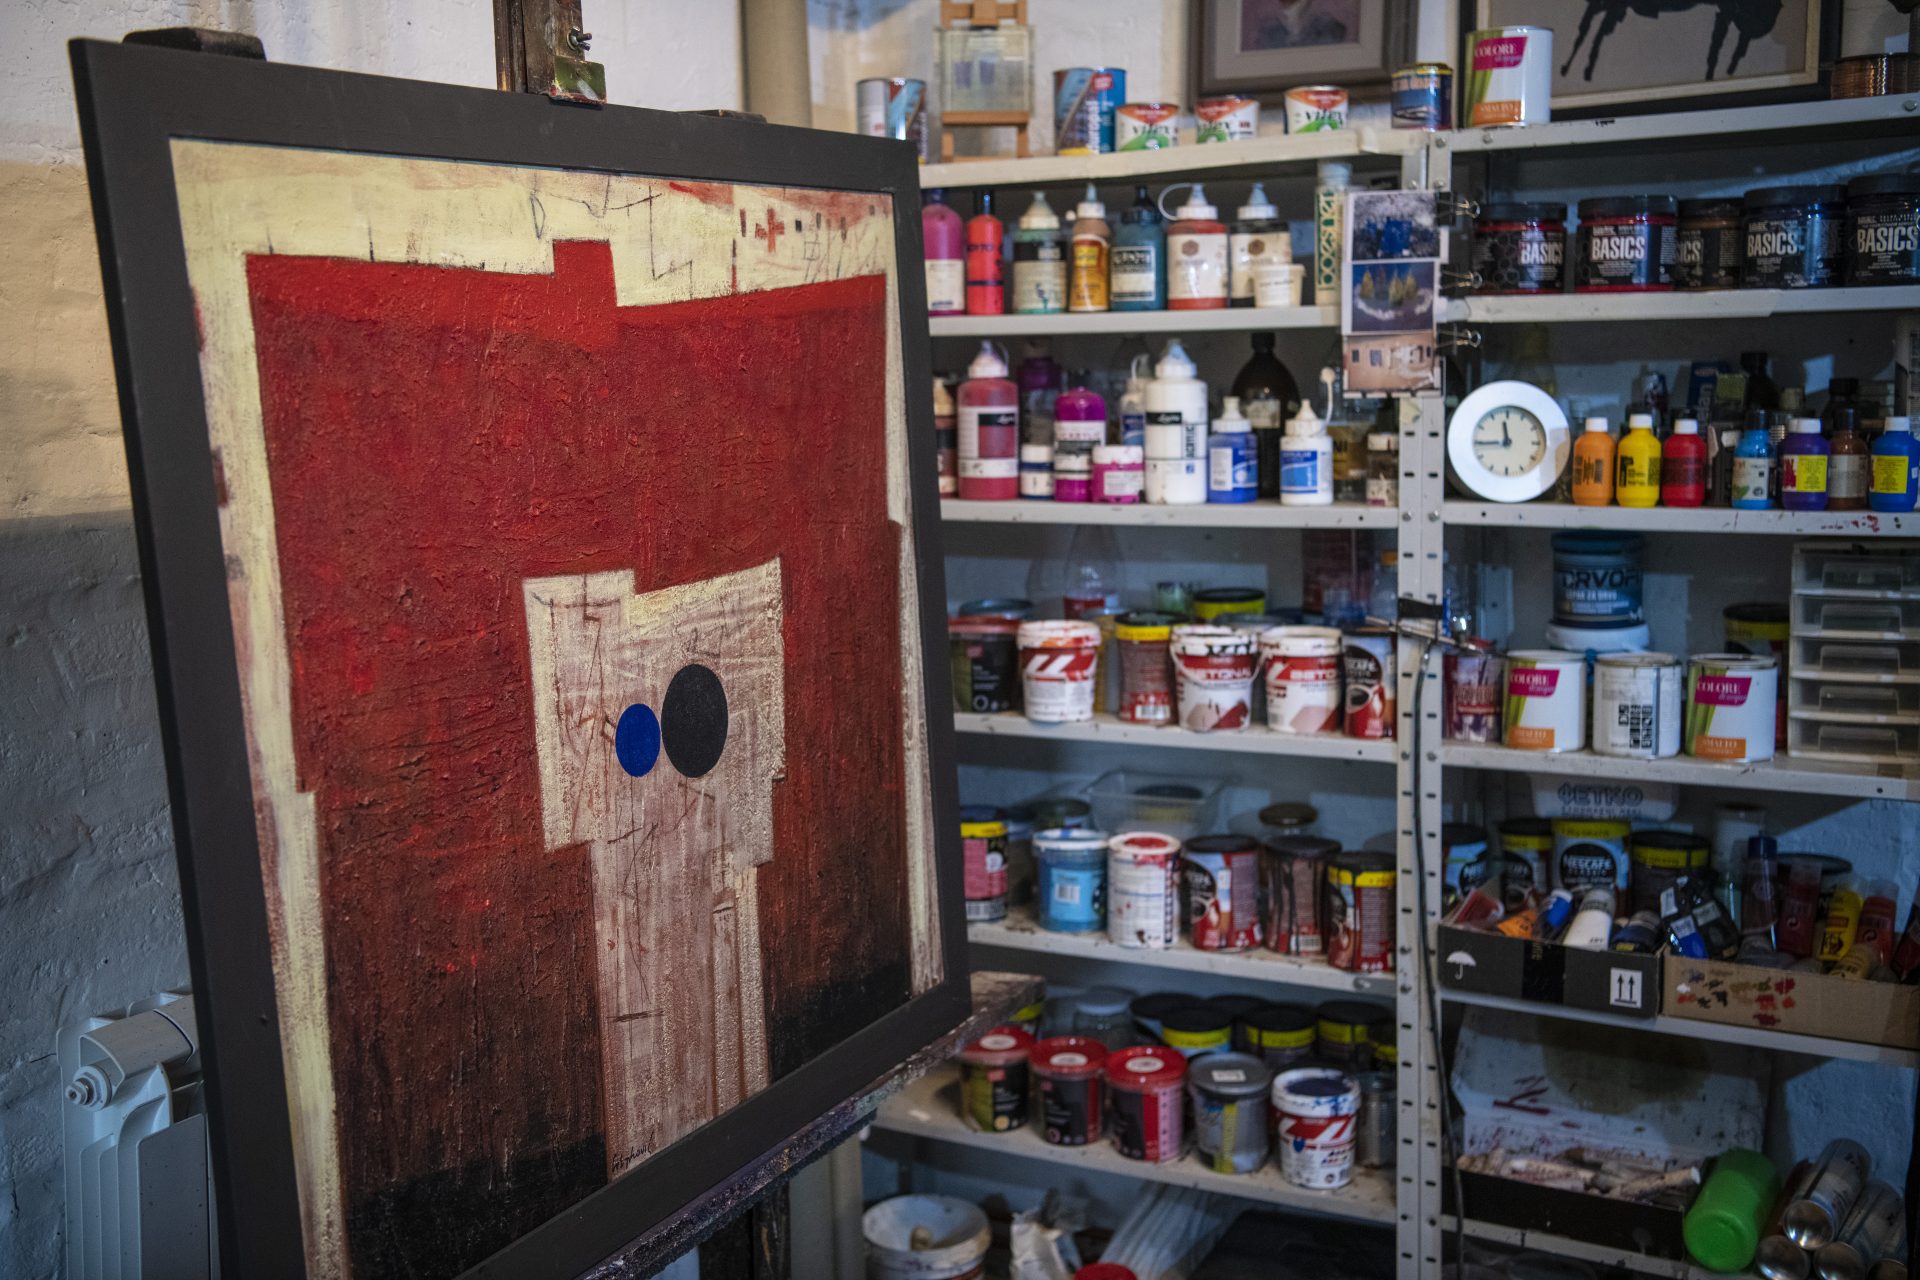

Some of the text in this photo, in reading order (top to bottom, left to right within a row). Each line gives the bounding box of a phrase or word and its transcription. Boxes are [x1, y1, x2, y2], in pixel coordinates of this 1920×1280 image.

[1475, 44, 1517, 57] COLORE
[1591, 236, 1646, 260] BASICS
[1747, 231, 1798, 257] BASICS
[1857, 225, 1919, 253] BASICS
[1520, 241, 1563, 265] BASICS
[1510, 673, 1549, 686] COLORE
[1697, 682, 1741, 694] COLORE
